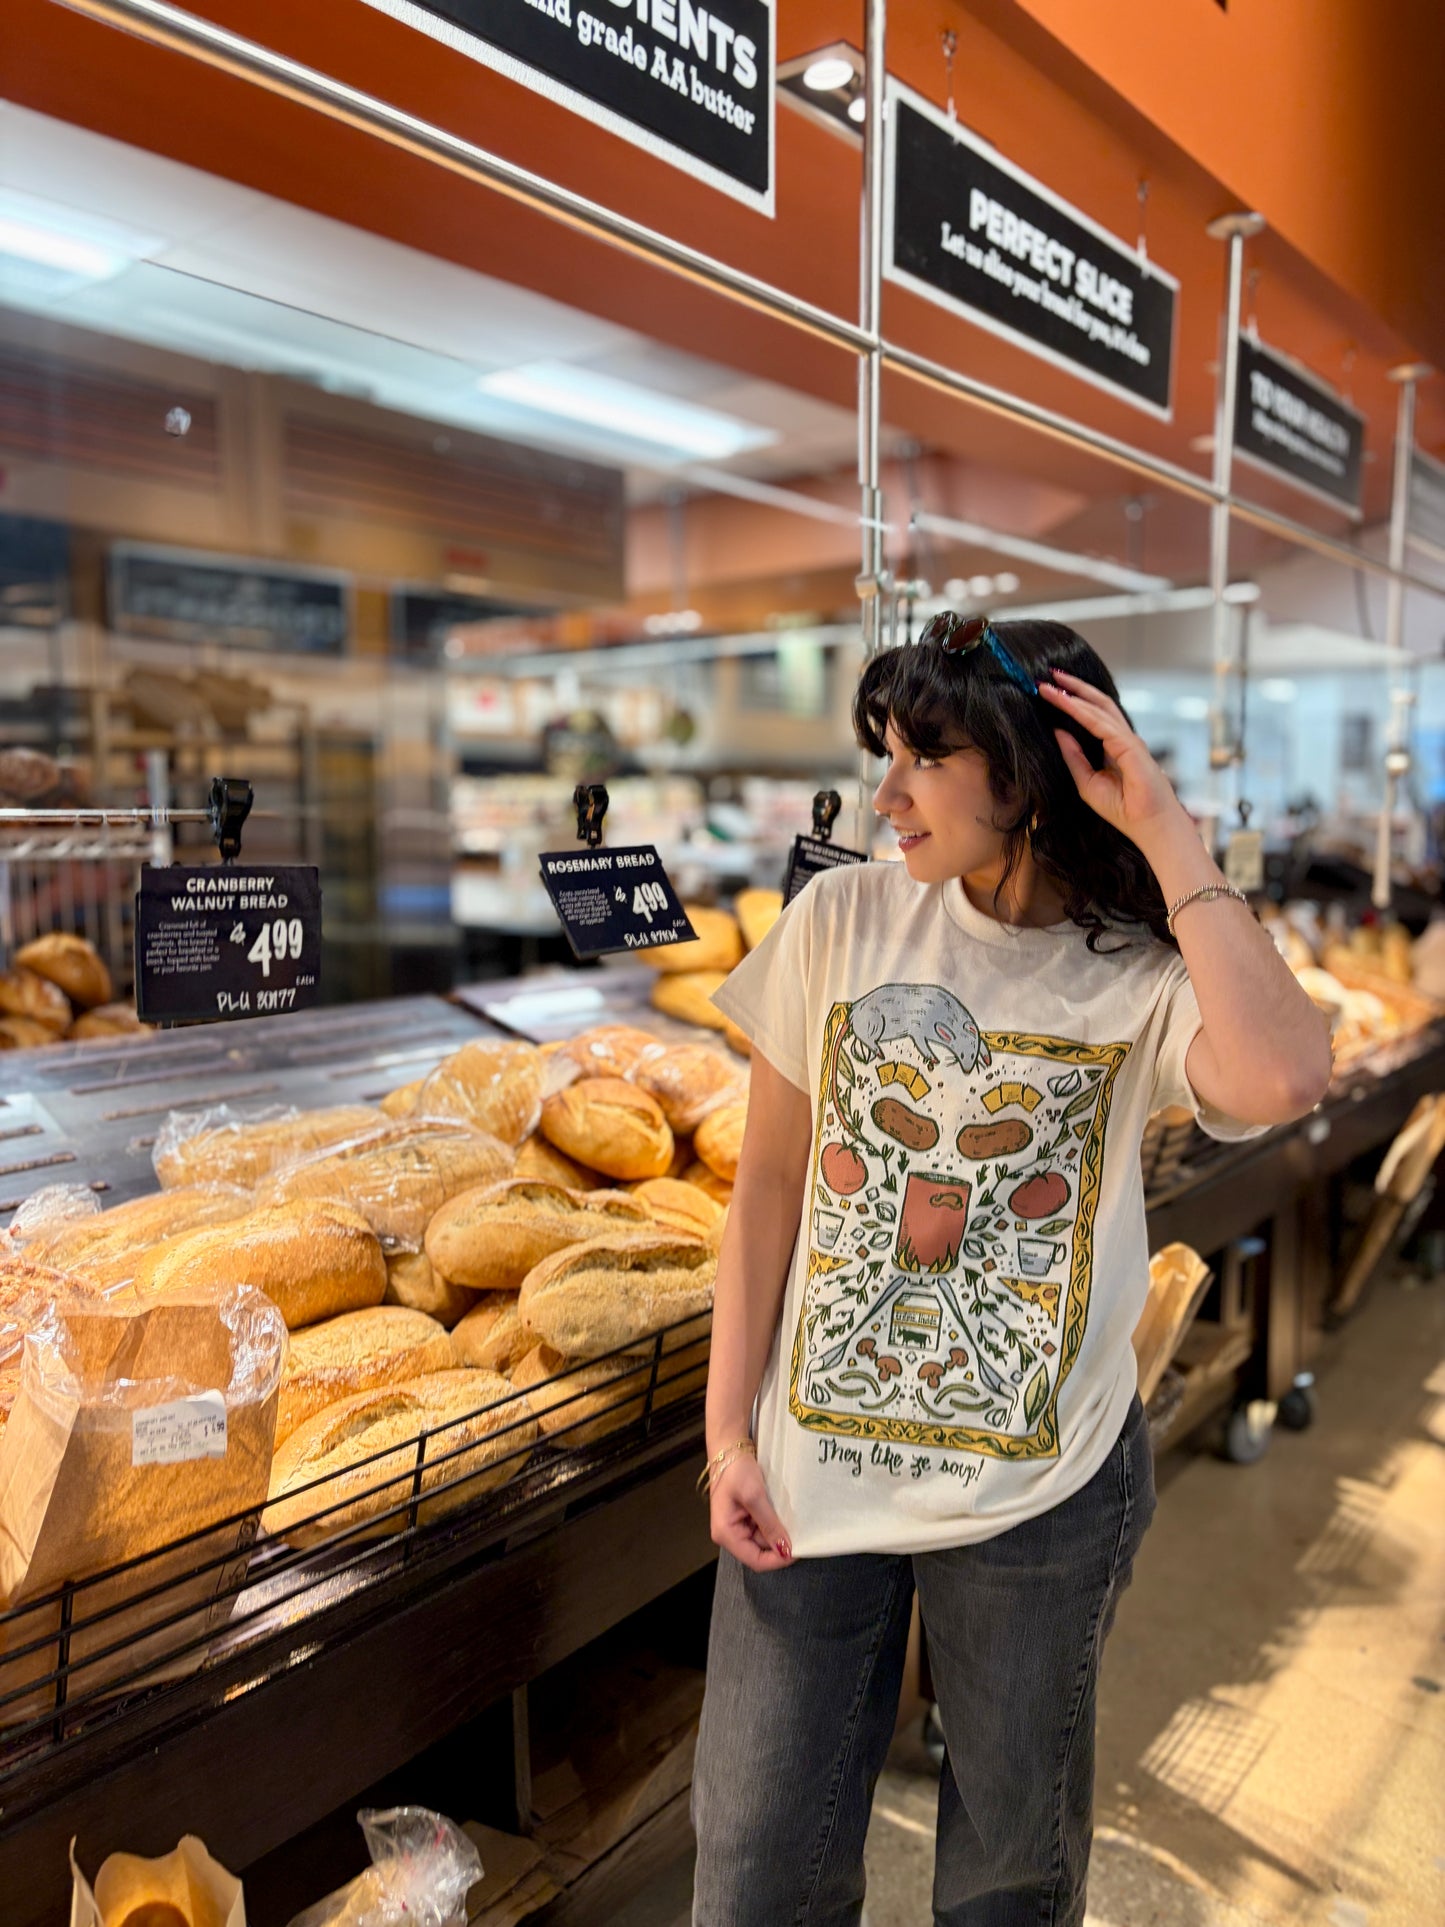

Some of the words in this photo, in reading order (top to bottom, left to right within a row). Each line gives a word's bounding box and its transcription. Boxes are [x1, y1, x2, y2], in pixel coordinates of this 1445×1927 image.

[606, 0, 758, 89] ENTS
[524, 0, 572, 28] nd
[576, 10, 648, 71] grade
[650, 46, 689, 97] AA
[690, 65, 756, 135] butter
[940, 221, 966, 260] Let
[968, 187, 1076, 288] PERFECT
[1075, 258, 1134, 326] SLICE
[186, 876, 275, 894] CRANBERRY
[547, 856, 613, 875] ROSEMARY
[616, 853, 655, 869] BREAD
[170, 895, 236, 912] WALNUT
[239, 893, 289, 910] BREAD
[247, 918, 303, 977] 499
[216, 991, 250, 1012] PLU
[818, 1437, 863, 1477] They
[870, 1439, 904, 1477] like
[938, 1457, 985, 1488] soup!
